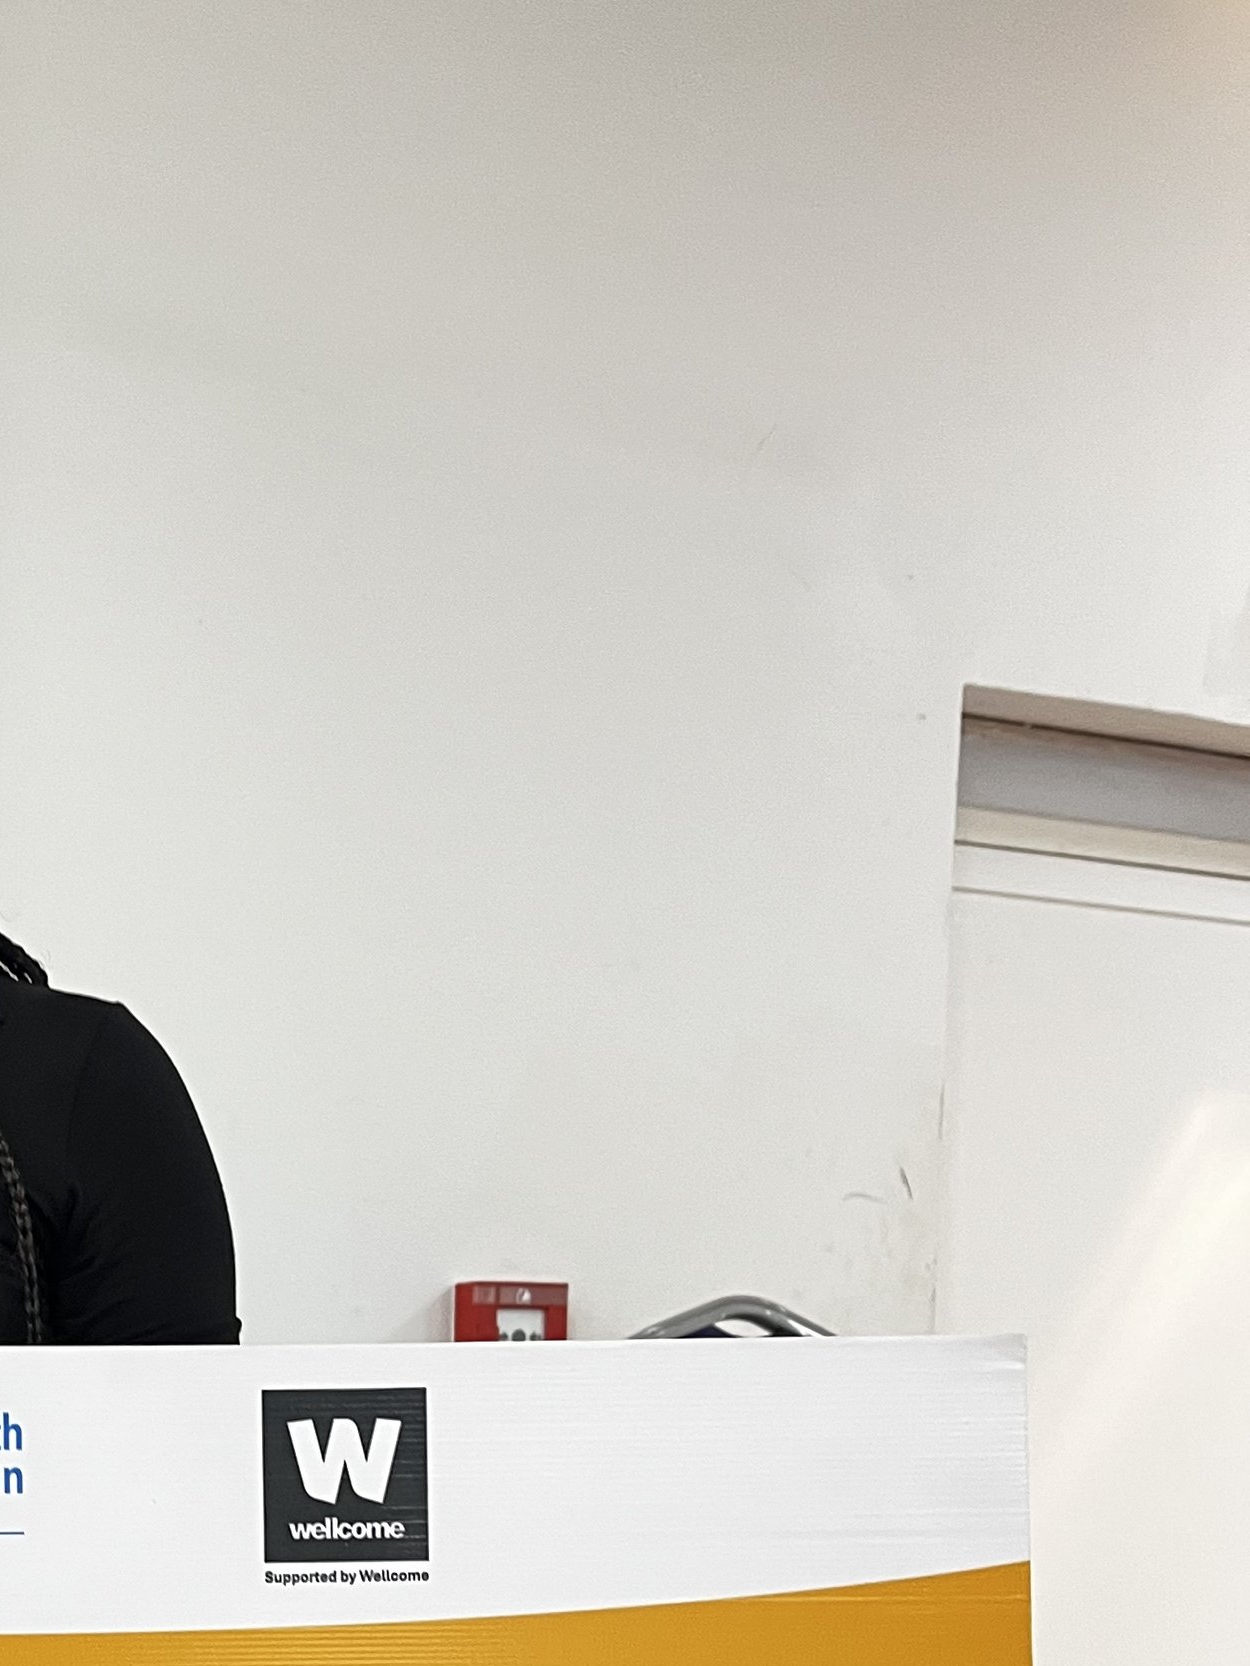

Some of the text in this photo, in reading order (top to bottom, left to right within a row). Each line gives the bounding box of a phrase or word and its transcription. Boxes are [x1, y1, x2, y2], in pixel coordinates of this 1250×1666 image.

[288, 1517, 406, 1540] wellcome
[264, 1569, 430, 1587] Supported by Wellcome
